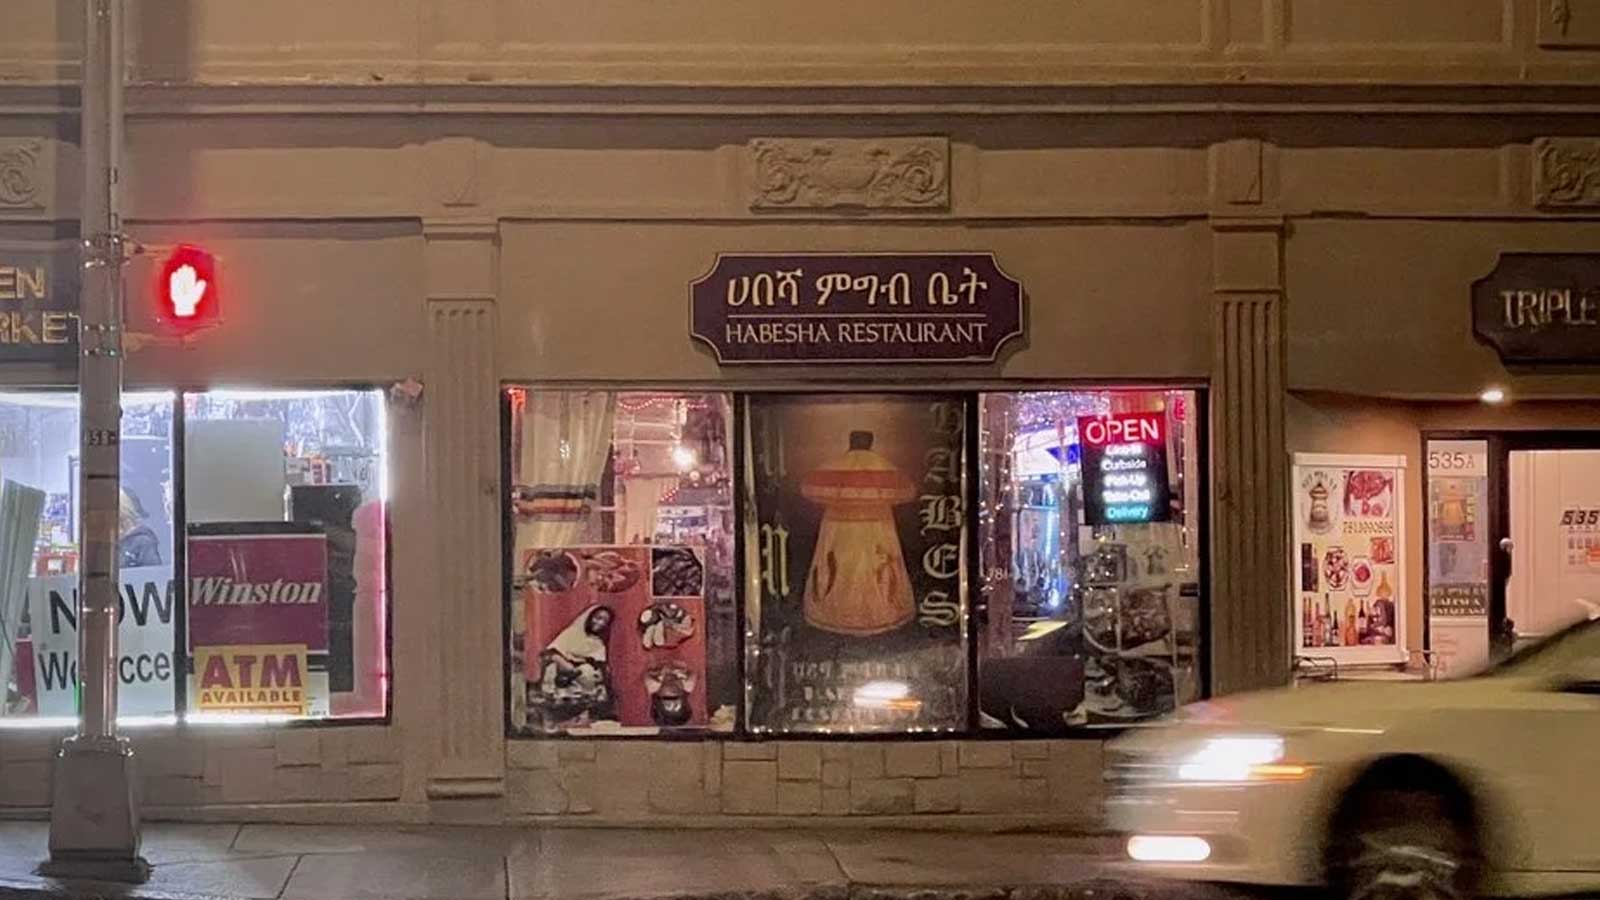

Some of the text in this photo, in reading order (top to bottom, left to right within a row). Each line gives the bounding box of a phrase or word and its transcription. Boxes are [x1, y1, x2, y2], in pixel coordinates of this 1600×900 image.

[727, 267, 987, 306] ሀበሻ ምግብ ቤት
[726, 322, 987, 343] HABESHA RESTAURANT
[1085, 418, 1160, 444] OPEN
[191, 576, 322, 606] Winston
[50, 579, 175, 635] NW
[201, 654, 302, 689] ATM
[202, 690, 300, 704] AVAILABLE
